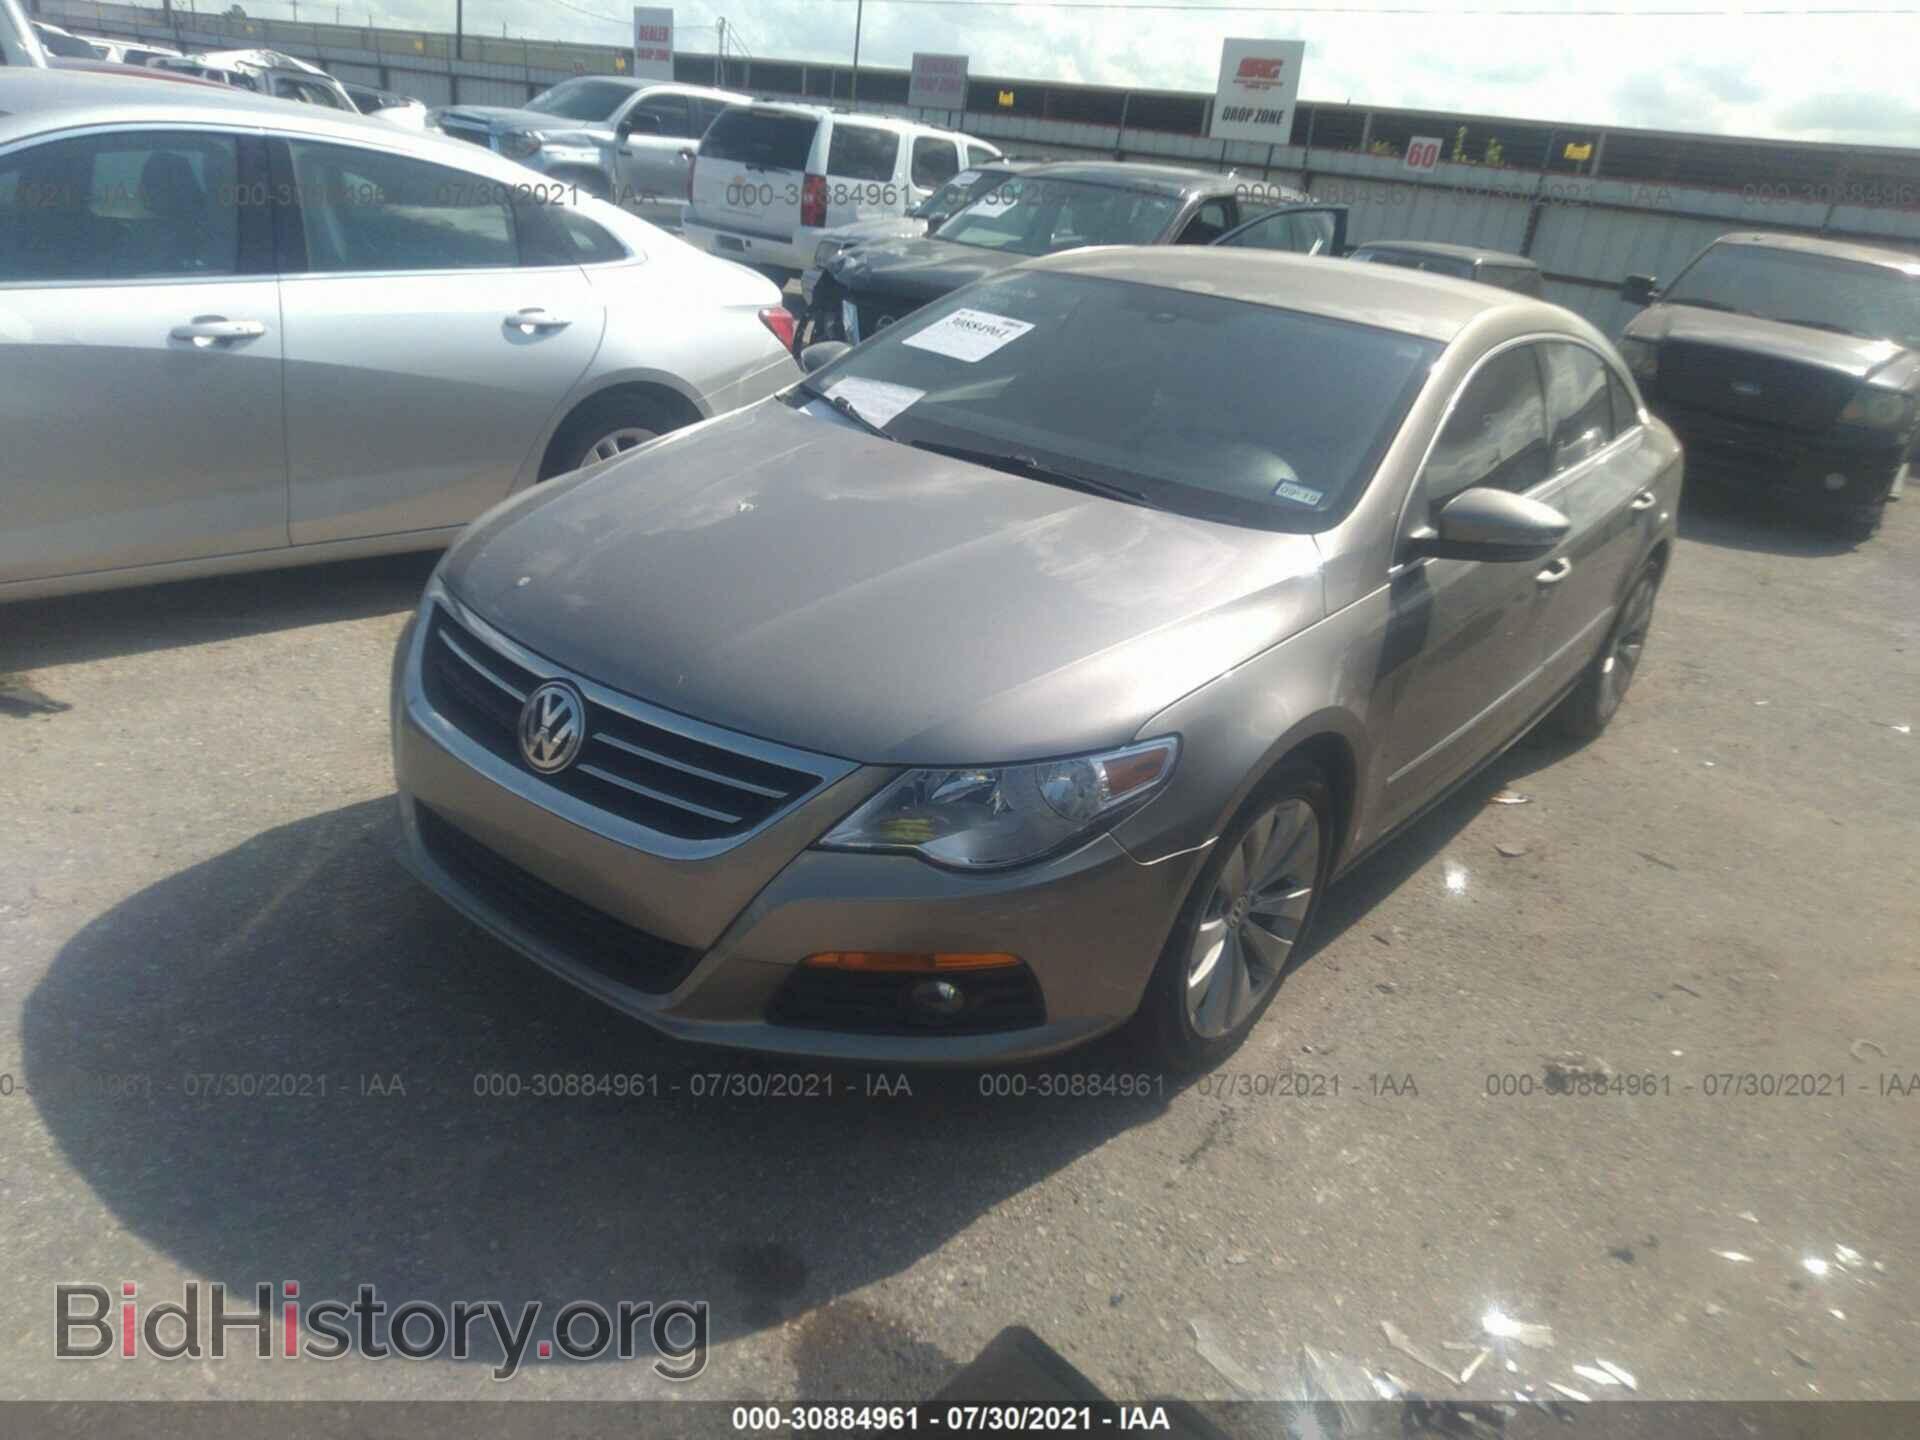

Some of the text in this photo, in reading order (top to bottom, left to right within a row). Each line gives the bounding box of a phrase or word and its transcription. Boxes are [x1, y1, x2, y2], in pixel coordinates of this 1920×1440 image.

[1222, 105, 1285, 125] DROP ZONE
[1408, 143, 1437, 168] 60
